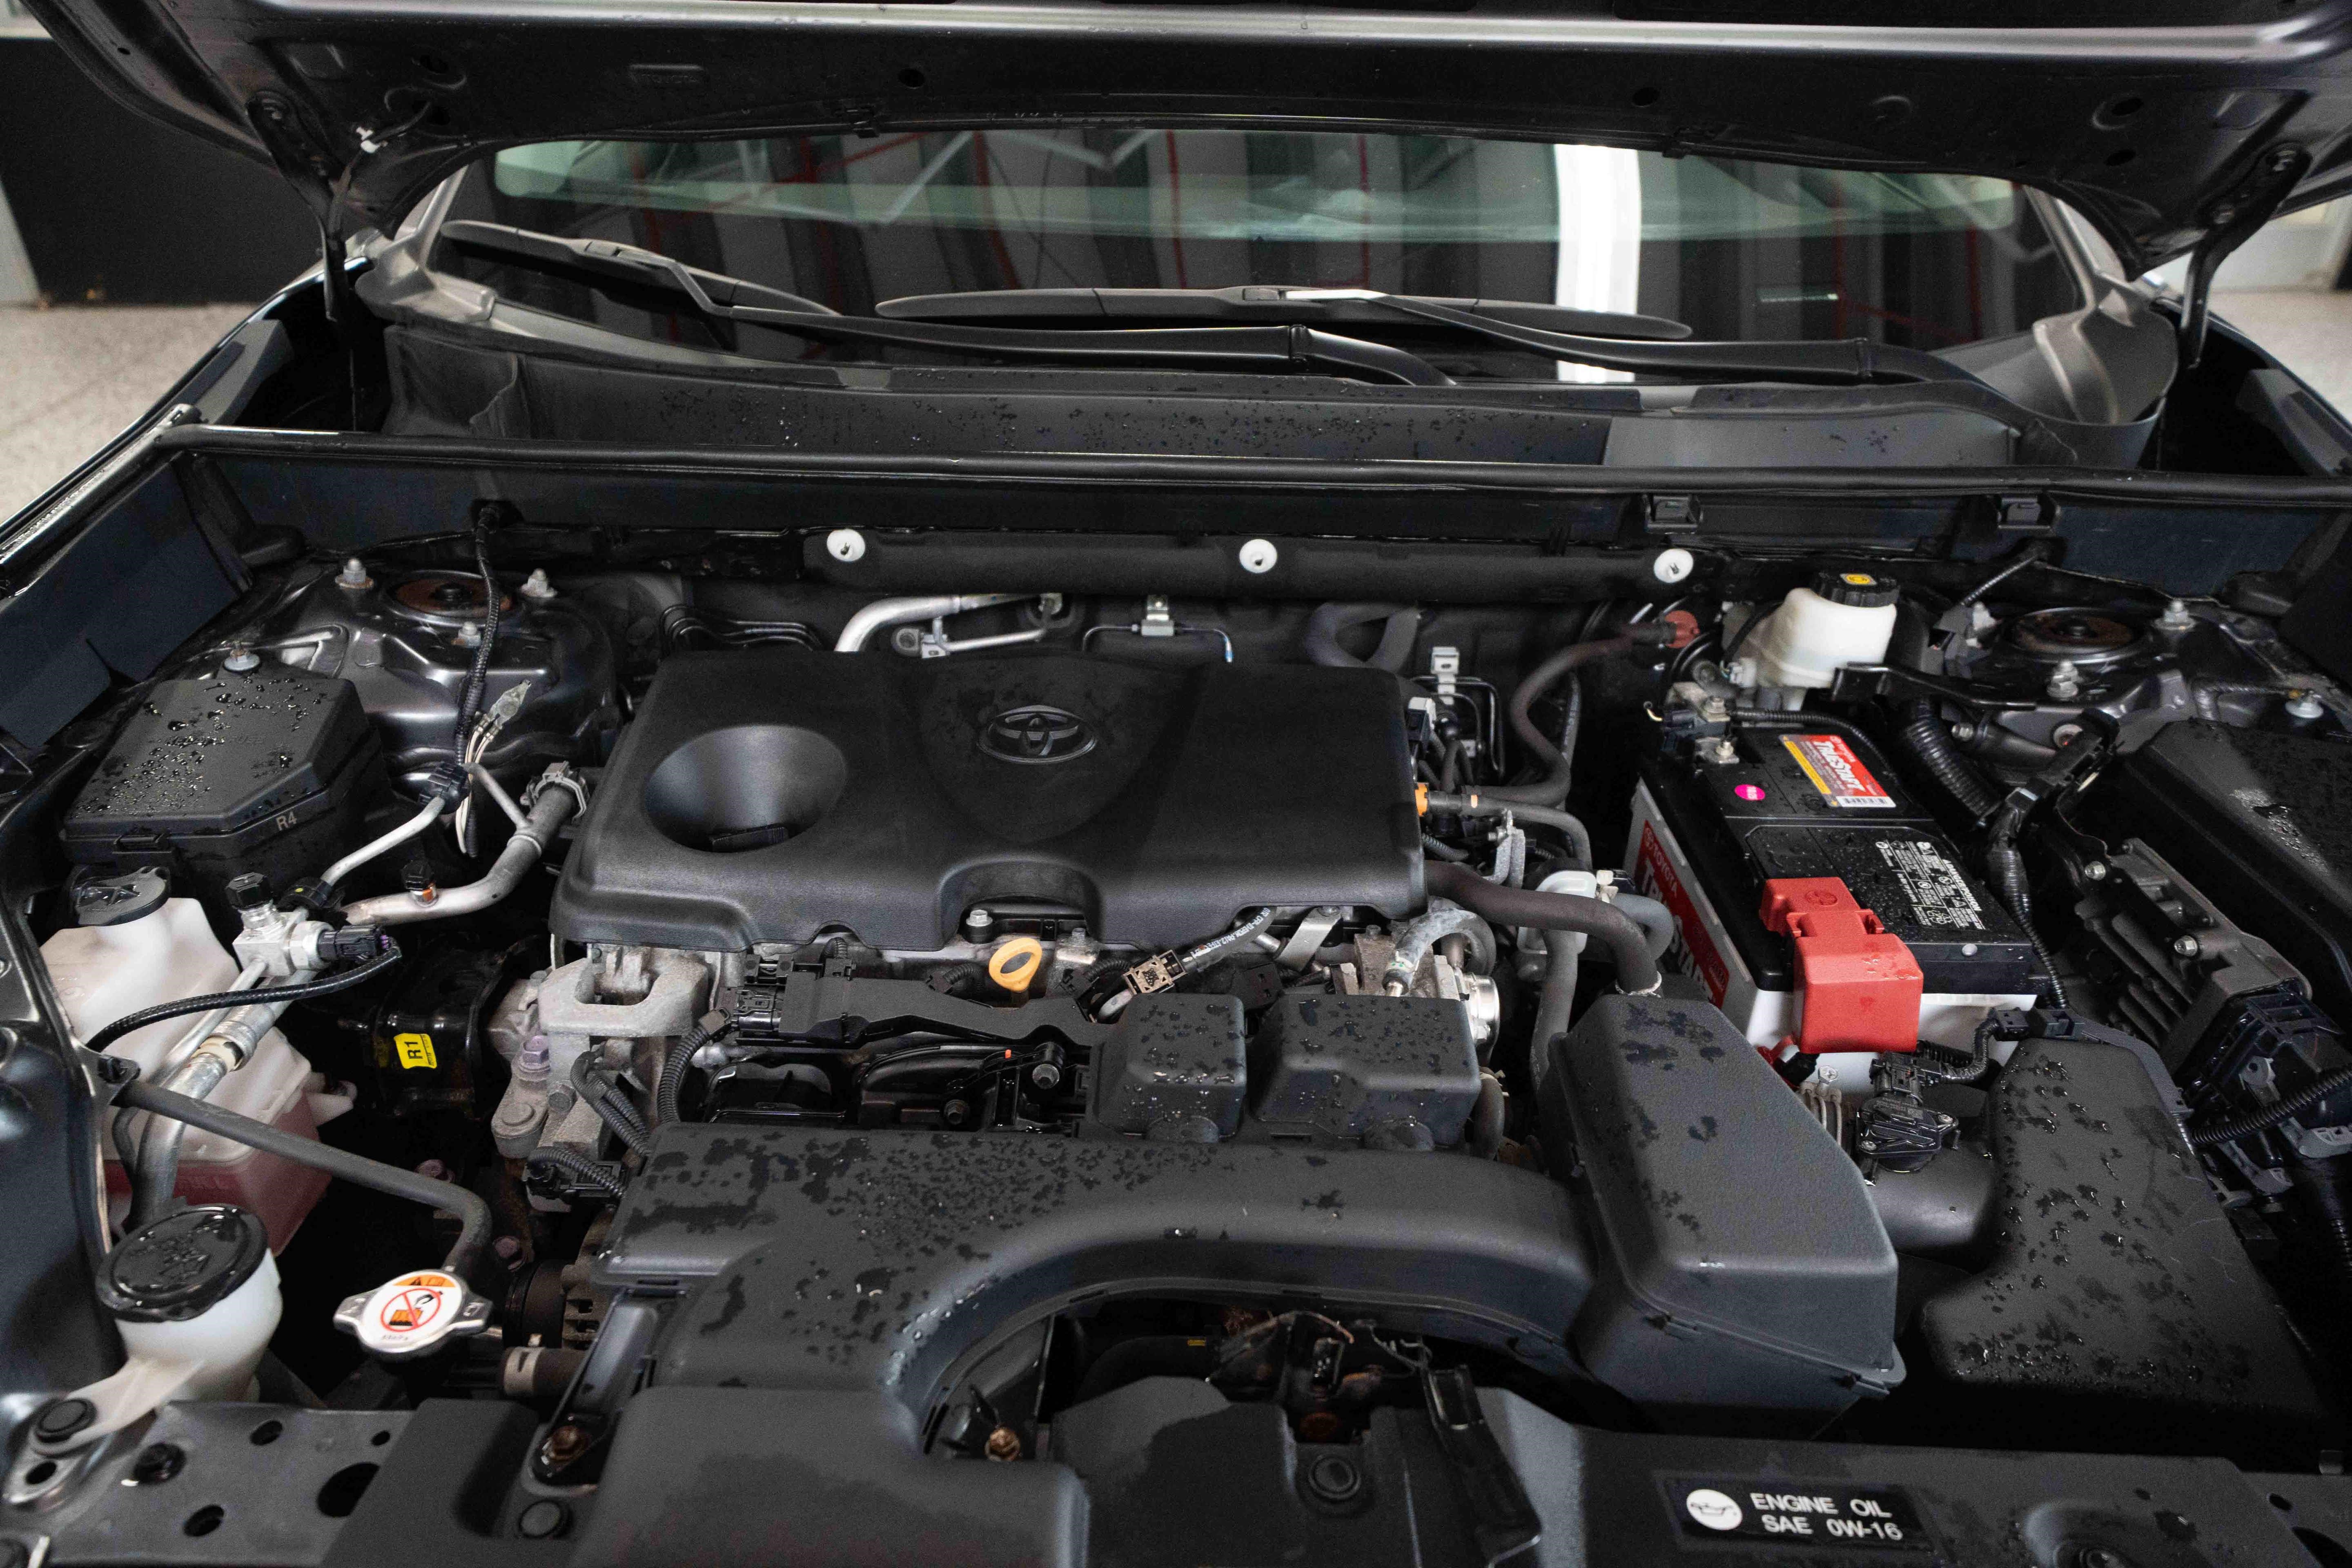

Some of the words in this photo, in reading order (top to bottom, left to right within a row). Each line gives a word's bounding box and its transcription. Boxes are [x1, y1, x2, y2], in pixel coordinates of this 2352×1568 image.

[276, 811, 297, 831] R4
[1653, 842, 1678, 899] TOYOTA
[404, 1041, 423, 1059] R1
[1750, 1492, 1839, 1514] ENGINE
[1850, 1499, 1893, 1518] OIL
[1761, 1514, 1814, 1534] SAE
[1826, 1519, 1903, 1541] 0W-16
